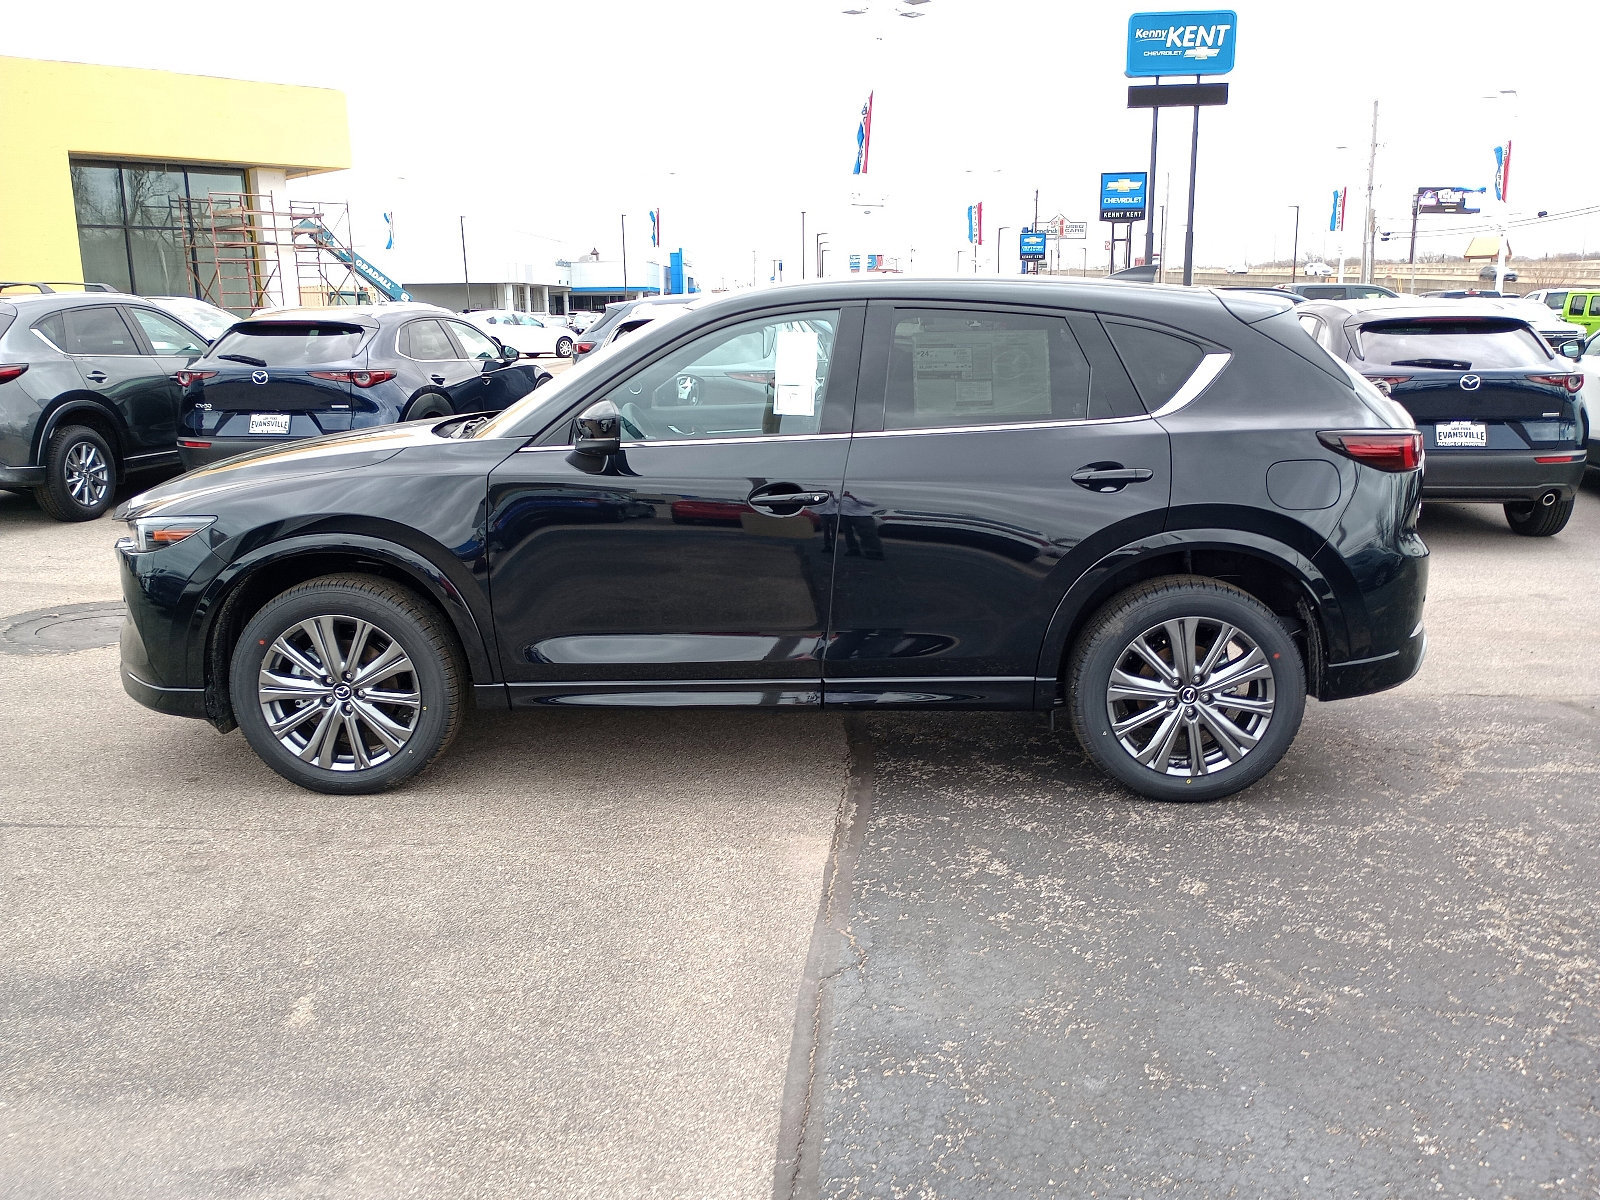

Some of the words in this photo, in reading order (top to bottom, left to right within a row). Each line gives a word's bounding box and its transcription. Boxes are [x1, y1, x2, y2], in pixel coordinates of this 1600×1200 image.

[1135, 28, 1168, 41] Kenny
[1166, 24, 1231, 48] KENT
[1103, 196, 1143, 204] CHEVROLET
[355, 259, 393, 290] GRADALL
[251, 420, 288, 430] EVANSVILLE
[1438, 431, 1485, 441] EVANSVILLE
